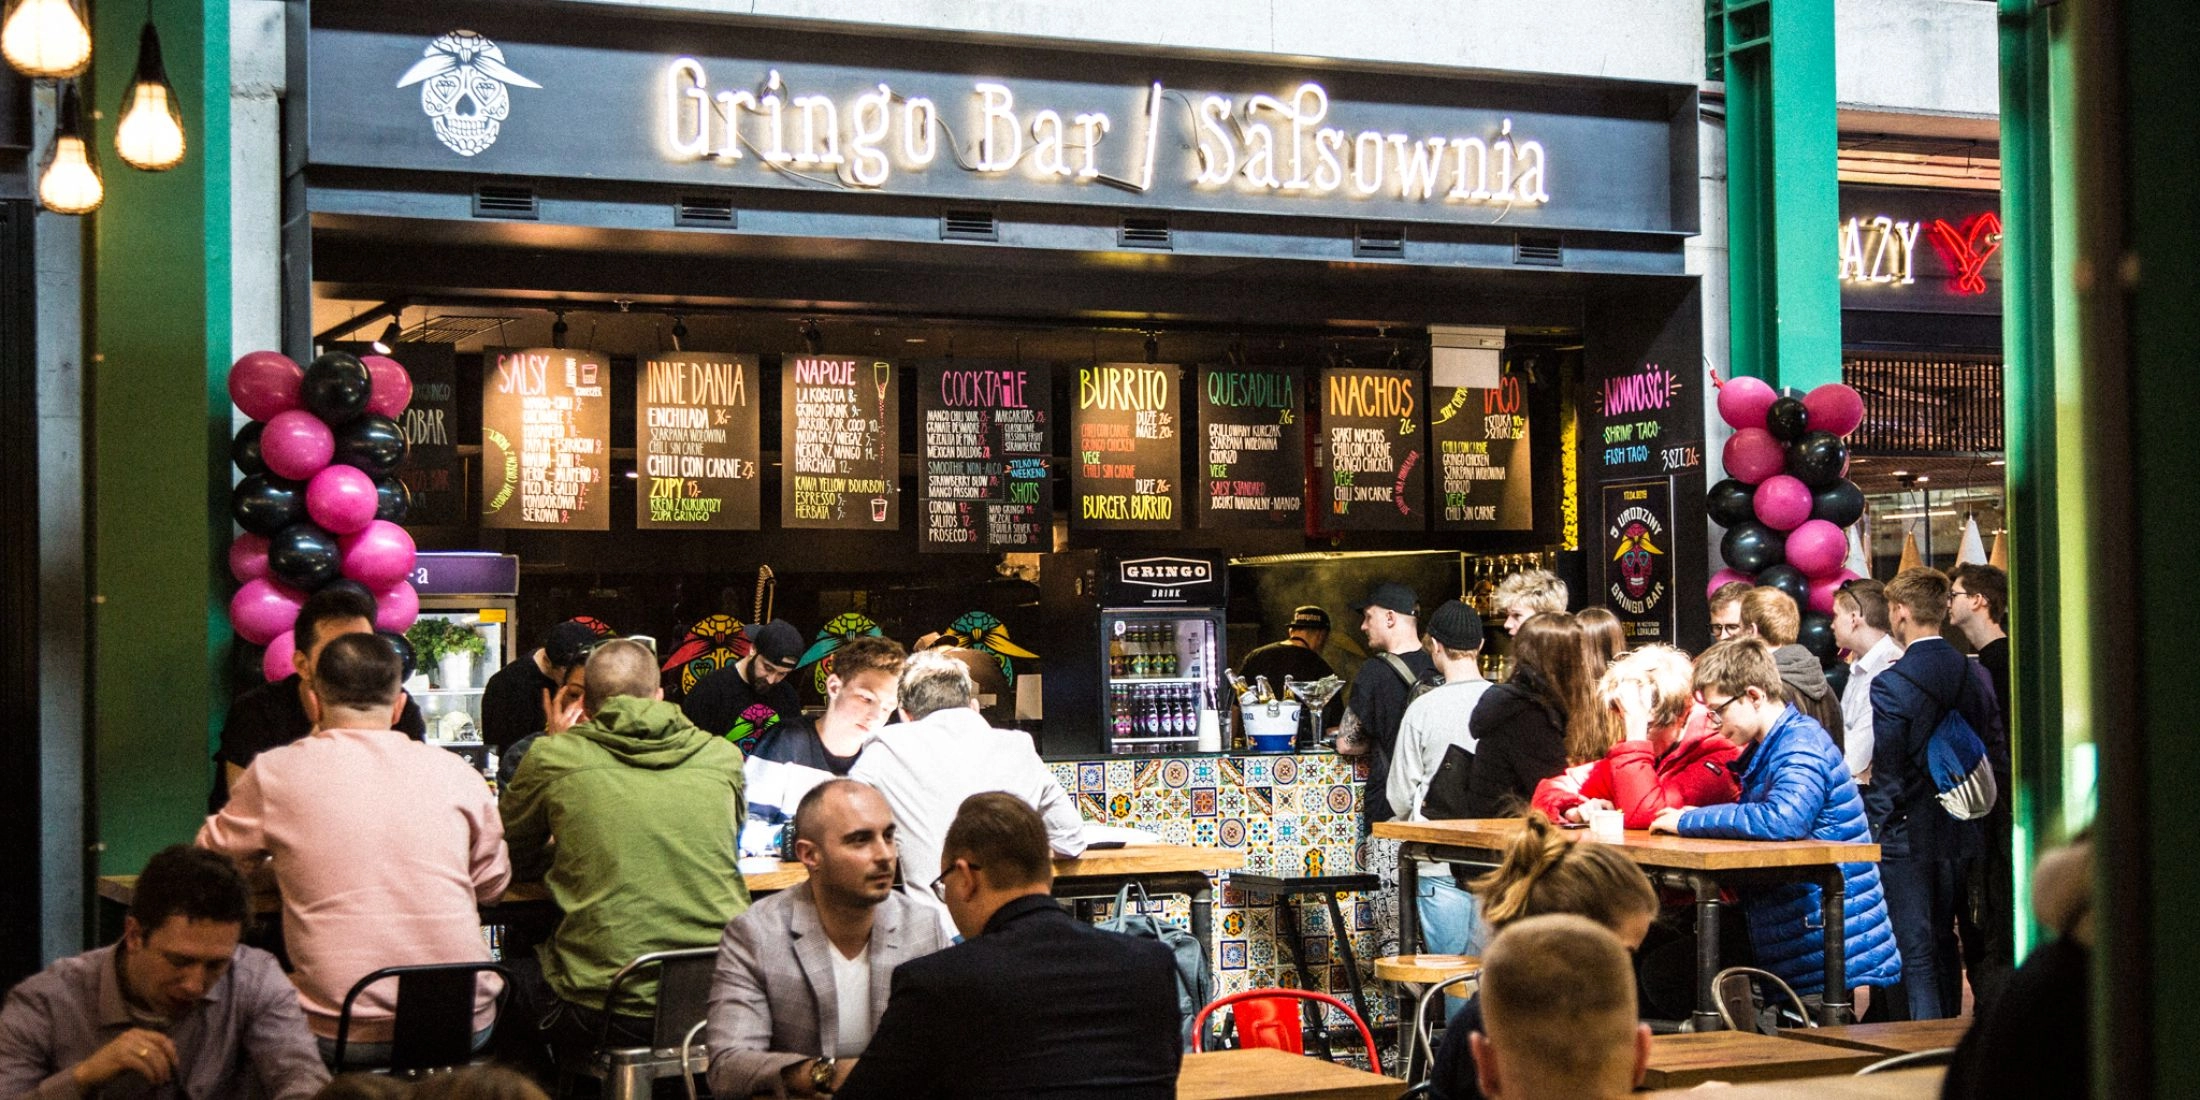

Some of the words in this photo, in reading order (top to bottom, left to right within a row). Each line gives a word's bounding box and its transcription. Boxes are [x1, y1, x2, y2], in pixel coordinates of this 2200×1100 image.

[668, 57, 936, 187] Gringo
[976, 82, 1110, 178] Bar
[1141, 81, 1163, 190] /
[1197, 82, 1550, 203] Salsownia
[1838, 216, 1920, 285] AZY
[497, 353, 550, 396] SALSY
[795, 359, 857, 386] NAPOJE
[647, 361, 687, 405] INNE
[691, 362, 746, 407] DANIA
[942, 370, 1028, 408] COCKTAILE
[1080, 367, 1168, 411] BURRITO
[1208, 372, 1294, 408] QUESADILLA
[796, 387, 809, 402] LA
[809, 387, 846, 403] KOGUTA
[1330, 375, 1415, 418] NACHOS
[647, 407, 710, 429] ENCHILADA
[796, 402, 824, 418] GRINGO
[825, 402, 849, 418] DRINK
[995, 409, 1036, 424] MARGARITAS
[847, 417, 866, 432] COCO
[1604, 422, 1634, 445] SHRIMP
[1635, 420, 1659, 440] TACO
[1354, 427, 1386, 443] NACHOS
[649, 441, 668, 454] CHILI
[671, 442, 681, 455] SIN
[682, 442, 705, 456] CARNE
[796, 443, 826, 459] NEKTAR
[834, 445, 862, 460] MANGO
[1209, 449, 1237, 464] CHORIZO
[1332, 441, 1350, 457] CHILI
[1350, 441, 1366, 457] CON
[1366, 441, 1392, 458] CARNE
[1604, 446, 1625, 466] FISH
[1625, 445, 1649, 463] TACO
[1082, 451, 1101, 464] VEGE
[1333, 456, 1362, 472] GRINGO
[1362, 456, 1393, 473] CHICKEN
[1442, 453, 1465, 466] GRINGO
[1465, 453, 1490, 466] CHICKEN
[647, 455, 679, 477] CHILI
[681, 455, 704, 478] CON
[706, 457, 742, 479] CARNE
[796, 458, 837, 474] HORCHATA
[928, 461, 965, 475] SMOOTHIE
[1010, 467, 1046, 479] WEEKEND
[1209, 464, 1228, 478] VEGE
[795, 476, 817, 492] KAWA
[818, 477, 848, 492] YELLOW
[848, 478, 885, 494] BOURBON
[1333, 470, 1355, 487] VEGE
[1444, 479, 1471, 494] CHORIZO
[554, 480, 579, 496] GALLO
[649, 477, 685, 499] ZUPY
[928, 486, 953, 498] MANGO
[953, 486, 980, 498] PASSION
[1009, 482, 1041, 504] SHOTS
[1334, 485, 1352, 501] CHILI
[1354, 486, 1367, 502] SIN
[1368, 486, 1393, 502] CARNE
[796, 491, 837, 506] ESPRESSO
[1211, 495, 1233, 510] JOGURT
[1445, 493, 1467, 507] VEGE
[522, 508, 560, 523] SEROWA
[796, 505, 831, 519] HERBATA
[928, 500, 957, 515] CORONA
[1083, 494, 1130, 520] BURGER
[1131, 494, 1172, 521] BURRITO
[1445, 506, 1461, 521] CHILI
[1474, 505, 1497, 521] CARNE
[651, 511, 671, 522] ZUPA
[673, 511, 710, 522] GRINGO
[1617, 506, 1663, 536] URODZINY
[928, 528, 968, 543] PROSECCO
[1127, 566, 1206, 578] GRINGO
[1151, 588, 1181, 598] DRINK
[1610, 582, 1645, 614] GRINGO
[1646, 581, 1665, 610] BAR
